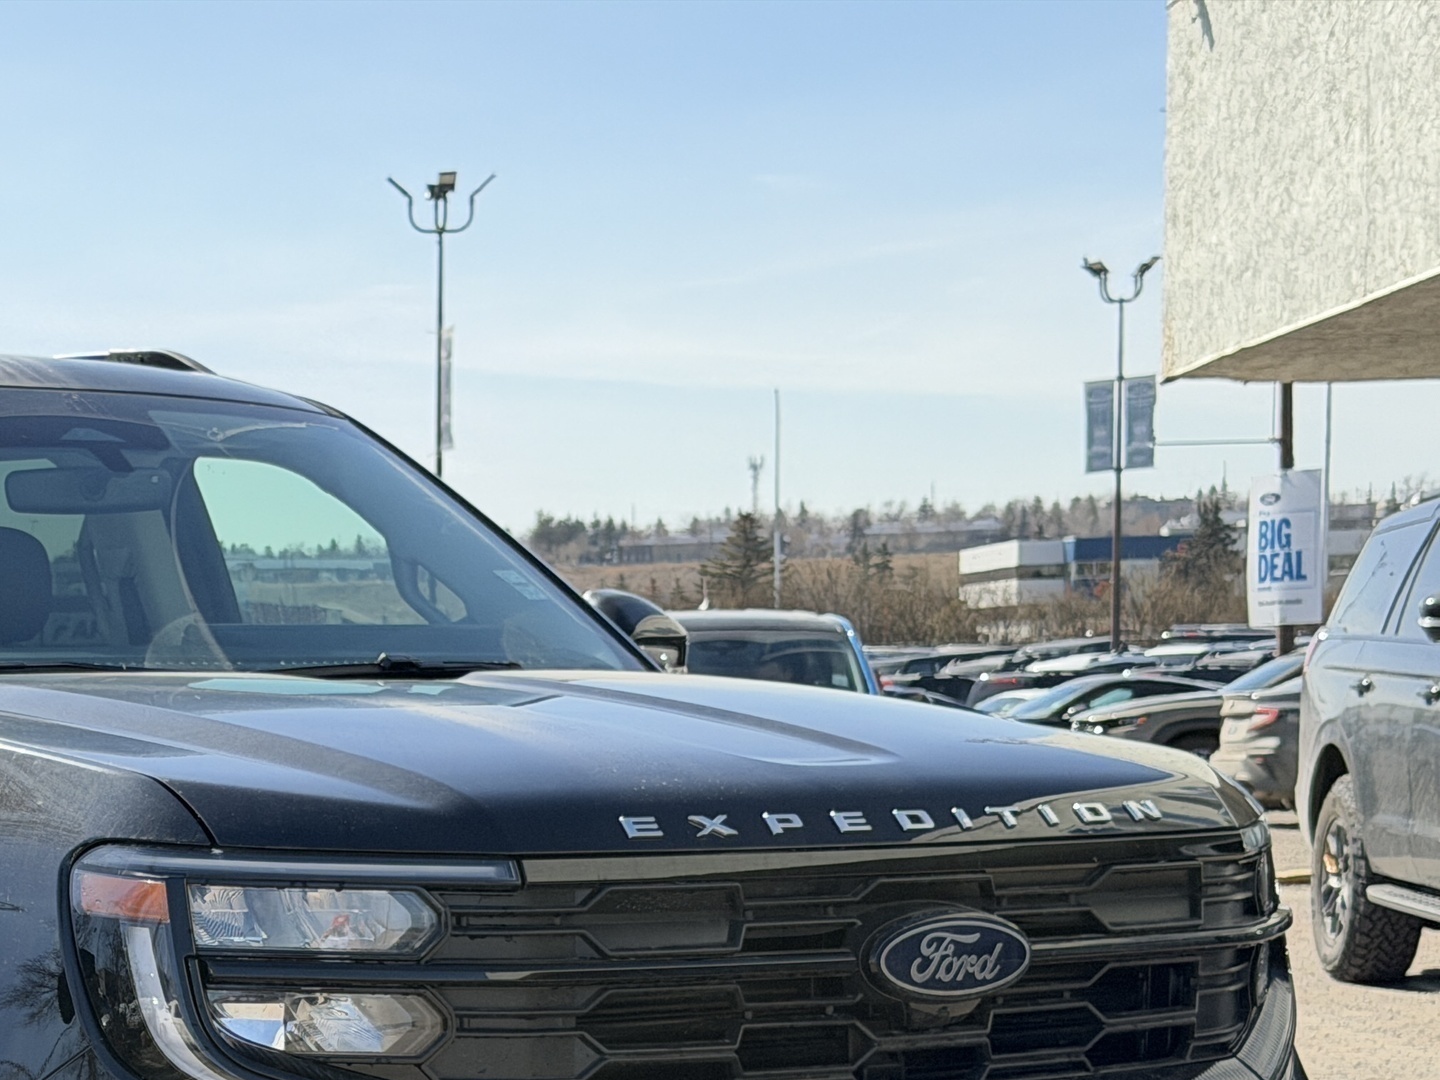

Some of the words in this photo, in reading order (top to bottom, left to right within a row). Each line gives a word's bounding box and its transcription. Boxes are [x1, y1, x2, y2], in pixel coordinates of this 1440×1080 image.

[1258, 517, 1291, 552] BIG
[1258, 550, 1307, 584] DEAL
[618, 799, 1164, 839] EXPEDITION
[910, 931, 1001, 983] Ford
